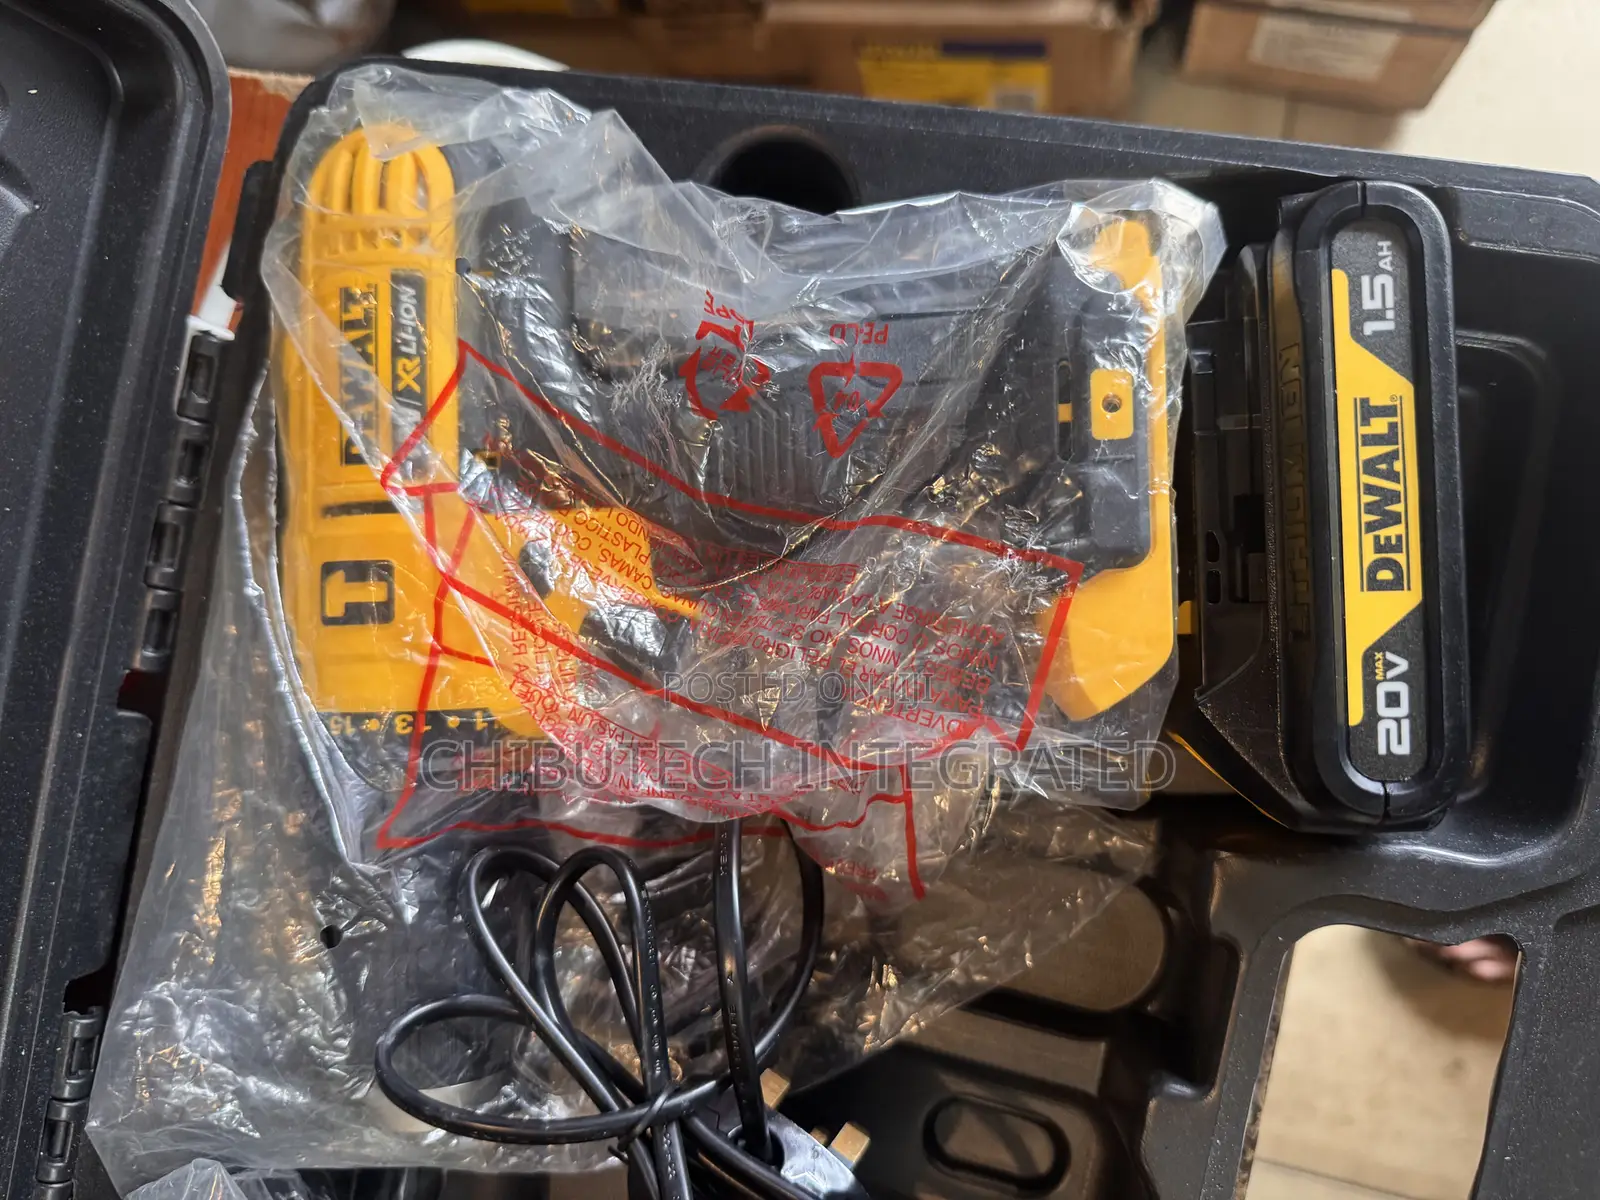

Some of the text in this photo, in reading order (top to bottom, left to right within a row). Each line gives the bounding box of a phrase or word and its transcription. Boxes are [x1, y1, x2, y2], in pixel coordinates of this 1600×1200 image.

[342, 285, 374, 465] DEWALT
[397, 355, 420, 393] XR
[572, 508, 652, 564] PLASTICO
[591, 543, 655, 591] CAMAS,
[833, 608, 909, 645] CORRAL
[751, 633, 832, 669] PELIGRO
[835, 656, 857, 676] EL
[930, 686, 984, 717] PARA
[1374, 650, 1412, 755] 20V MAX
